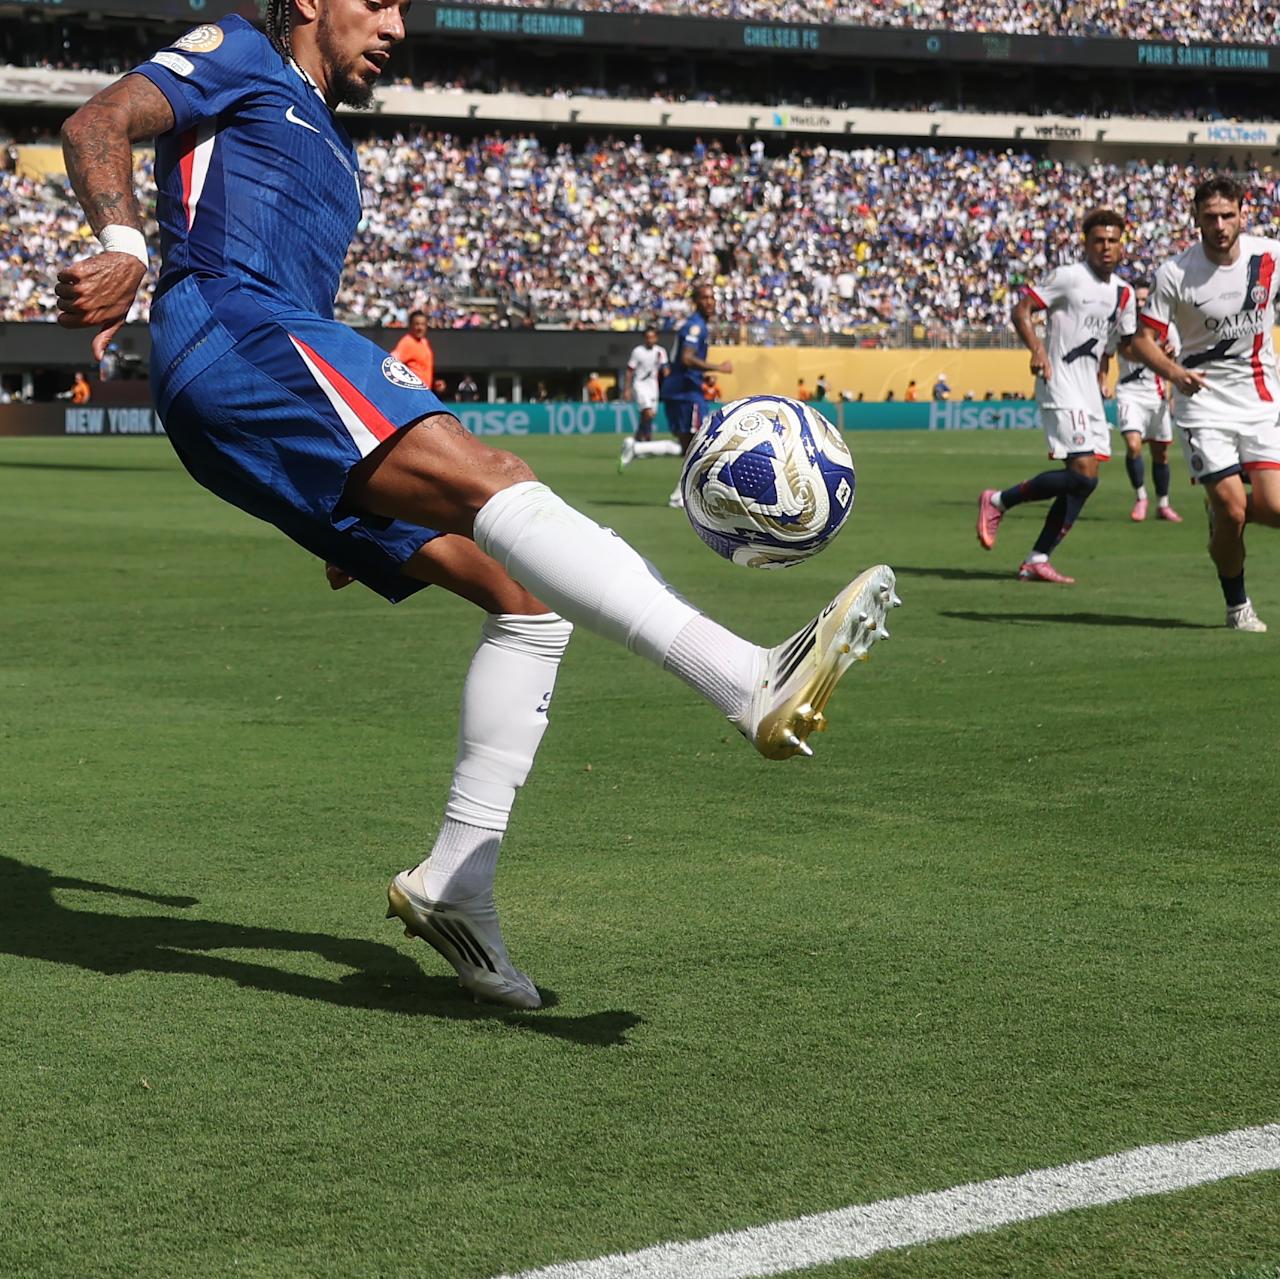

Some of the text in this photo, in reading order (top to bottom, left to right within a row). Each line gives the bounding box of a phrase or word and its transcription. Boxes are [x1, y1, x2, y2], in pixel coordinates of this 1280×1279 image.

[436, 9, 584, 37] PARIS SAINT-GERMAIN
[744, 25, 819, 49] CHELSEA FC
[1138, 45, 1269, 69] PARIS SAINT-GERMAIN
[1034, 124, 1081, 139] verizon
[1207, 126, 1267, 141] HCLTech
[1205, 310, 1264, 331] QATAR
[1220, 325, 1264, 339] AIRWAYS
[65, 408, 104, 434] NEW
[107, 408, 153, 434] YORK
[1070, 409, 1086, 431] 14
